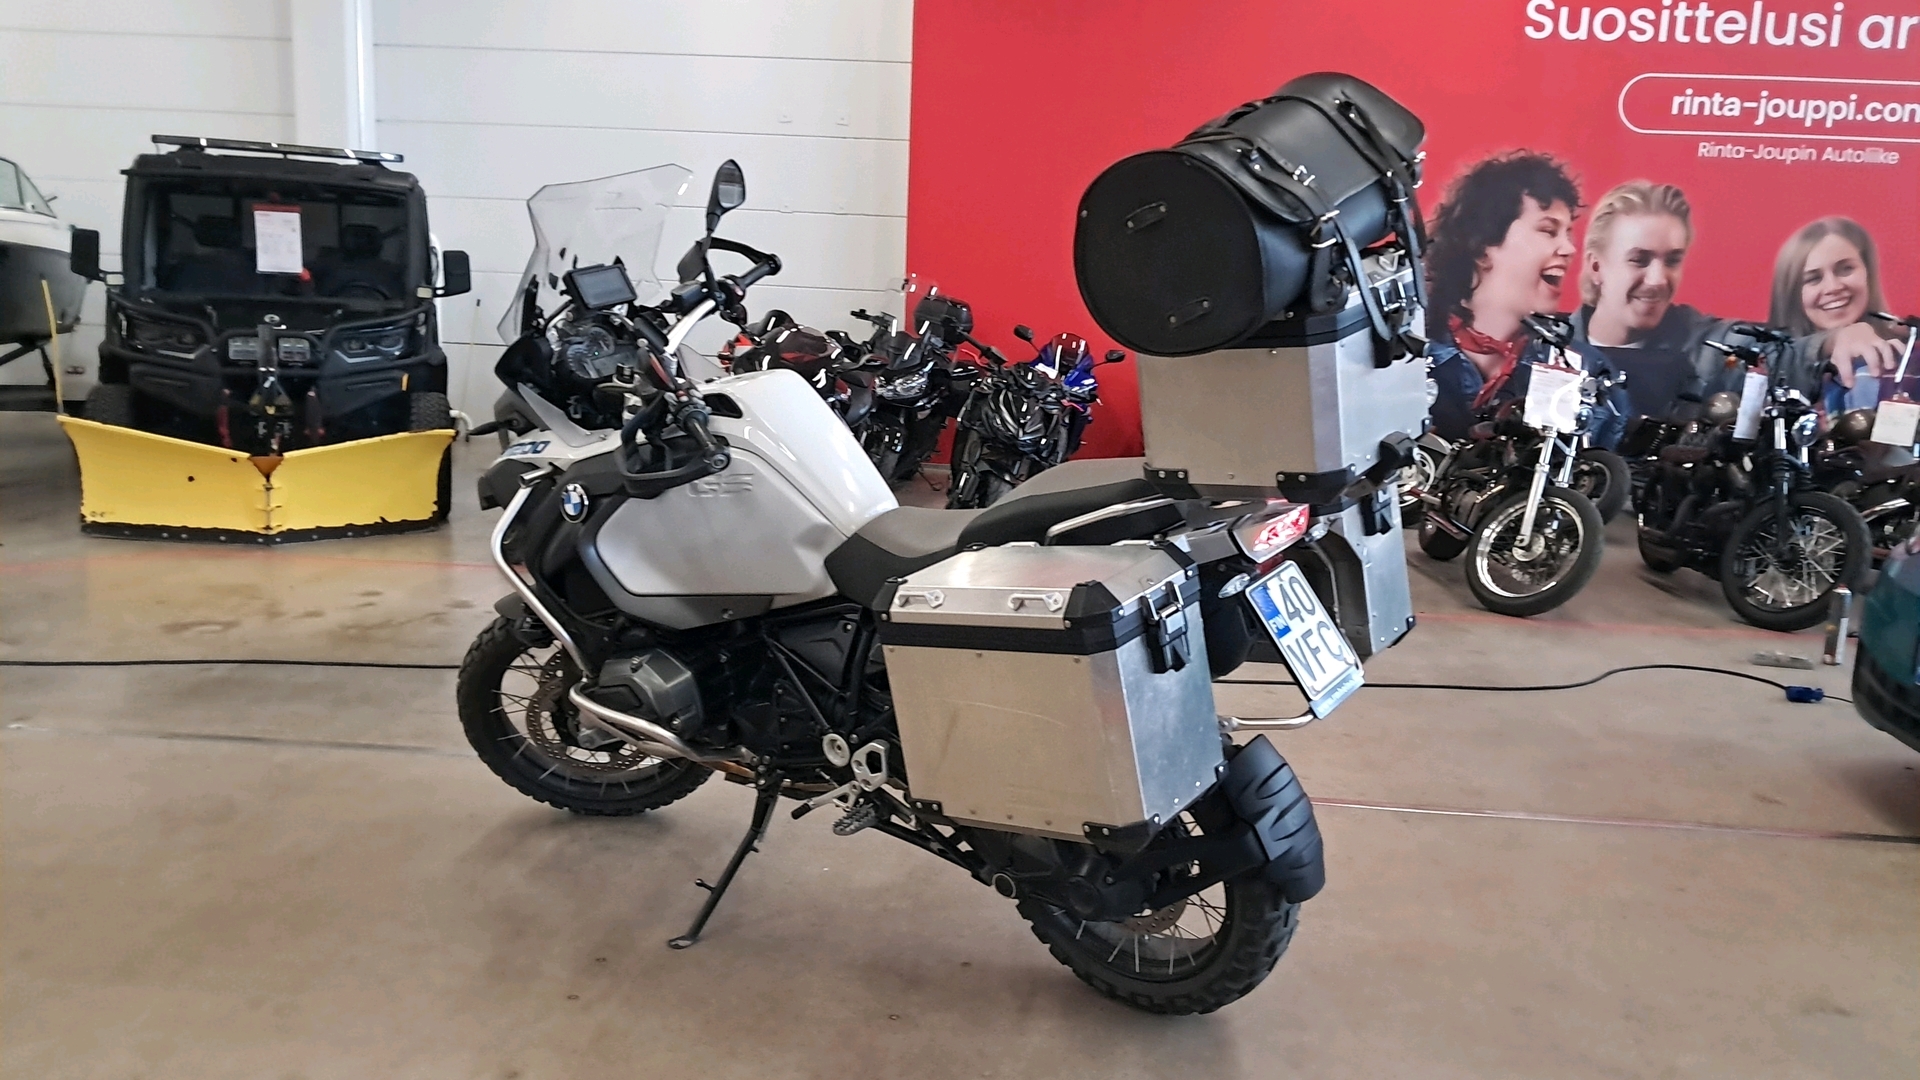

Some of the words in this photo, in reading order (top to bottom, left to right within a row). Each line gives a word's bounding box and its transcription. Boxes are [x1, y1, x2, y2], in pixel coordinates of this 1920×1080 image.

[1524, 0, 1845, 48] Suosittelusi
[1858, 14, 1920, 50] ar
[1697, 142, 1817, 165] Rinta-Joupin
[1278, 575, 1316, 623] 40
[1269, 613, 1289, 634] FIN
[1286, 620, 1346, 682] VFC
